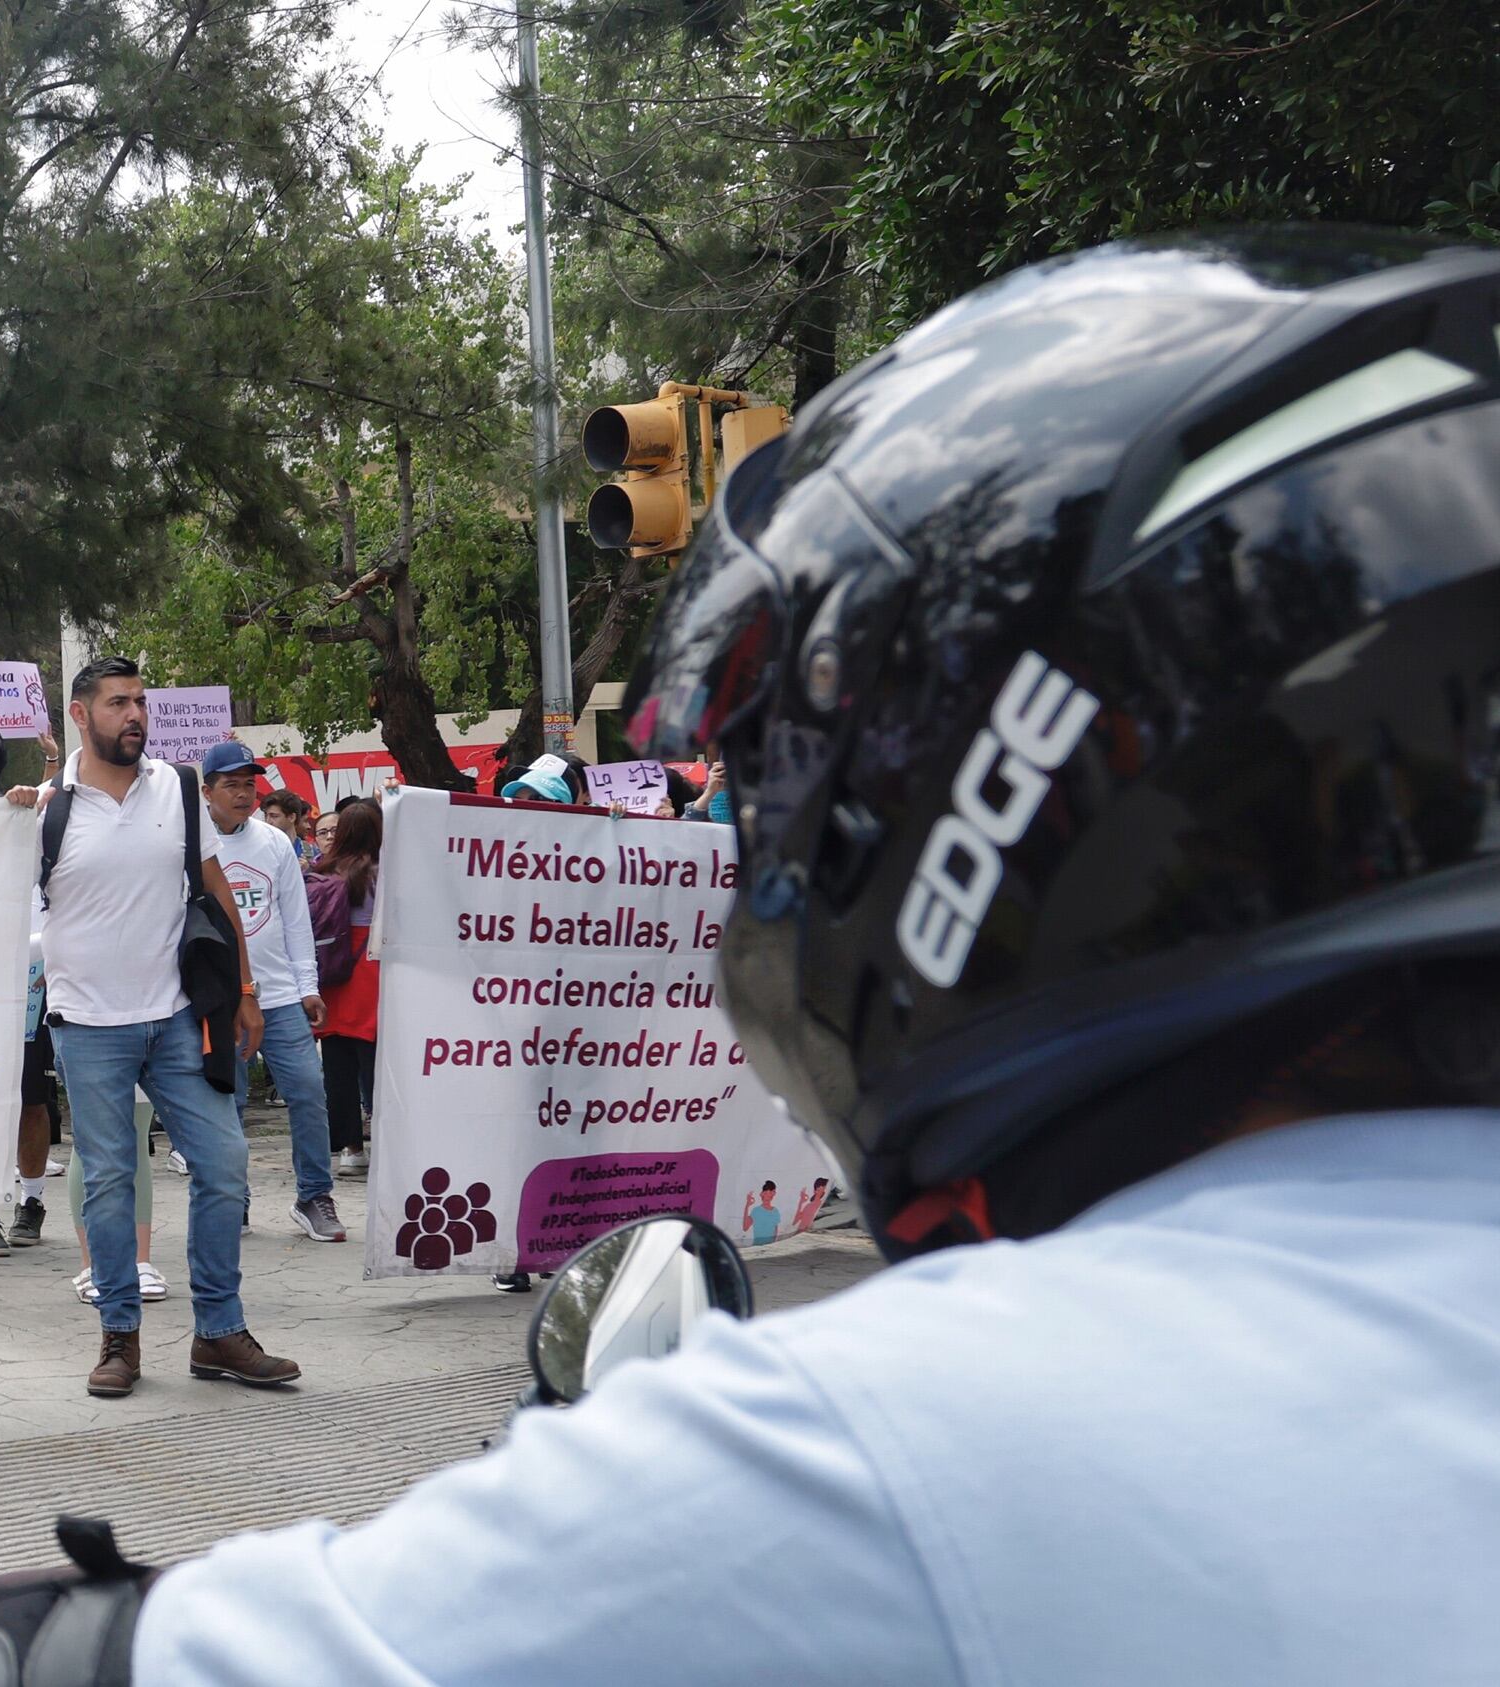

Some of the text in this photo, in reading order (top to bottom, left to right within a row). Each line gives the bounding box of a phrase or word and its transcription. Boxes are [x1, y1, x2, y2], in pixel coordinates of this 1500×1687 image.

[158, 703, 173, 716] NO
[174, 703, 191, 715] HAY
[191, 704, 227, 715] JUSTICIA
[154, 717, 219, 728] PARA EL PUEBLO
[156, 751, 168, 760] EL
[592, 771, 612, 787] La
[896, 649, 1100, 988] EDGE
[447, 836, 606, 884] "México
[618, 844, 698, 889] libra
[235, 890, 263, 908] JF
[457, 910, 516, 942] sus
[529, 902, 680, 954] batallas,
[472, 968, 719, 1008] conciencia ciu
[422, 1036, 512, 1076] para
[521, 1026, 681, 1067] defender
[688, 1029, 718, 1067] la
[538, 1086, 571, 1129] de
[570, 1161, 677, 1183] #TodosSomosPJF
[548, 1180, 691, 1207] #IndependenciaJudicial
[527, 1235, 596, 1254] #UnidosSo
